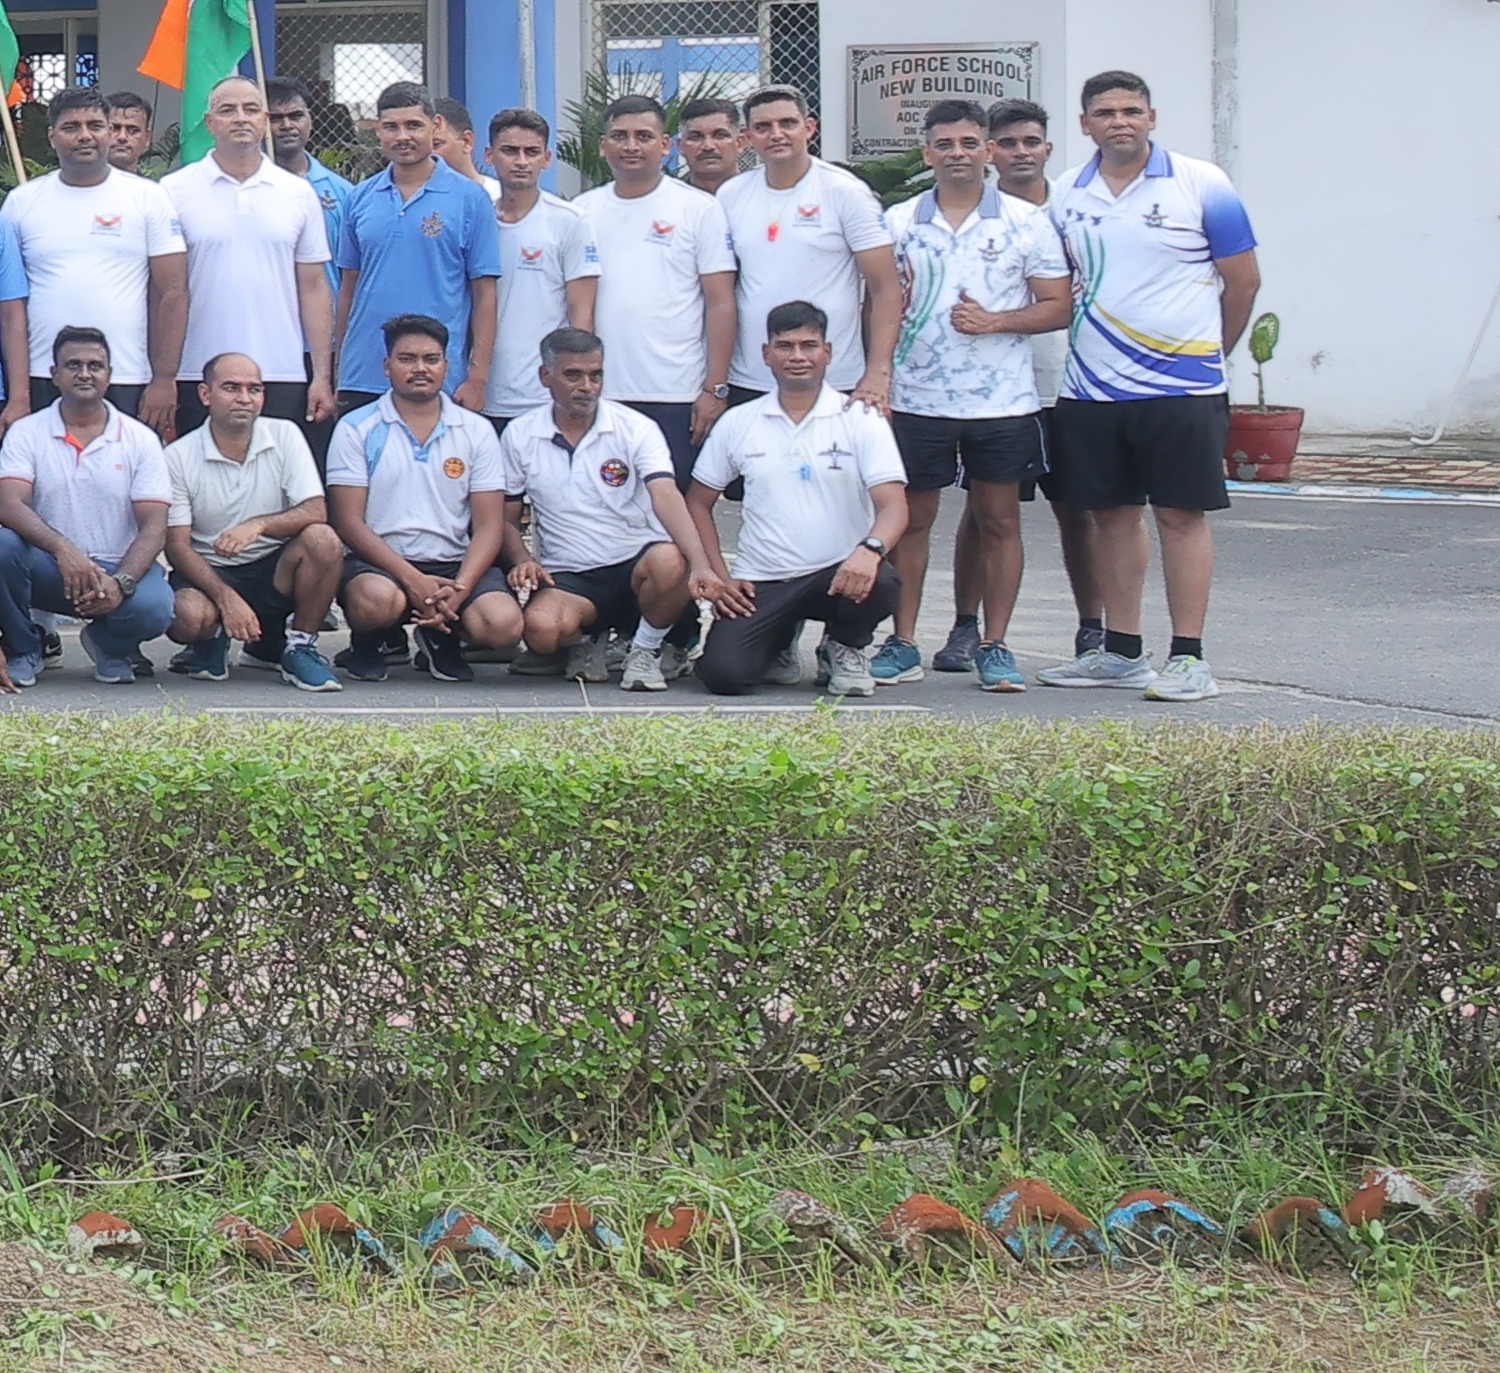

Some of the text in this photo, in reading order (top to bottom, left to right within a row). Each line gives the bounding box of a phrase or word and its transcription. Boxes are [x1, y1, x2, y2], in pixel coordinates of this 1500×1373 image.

[860, 56, 1025, 84] AIR FORCE SCHOOL
[879, 77, 1004, 99] NEW BUILDING
[896, 112, 920, 123] AOC
